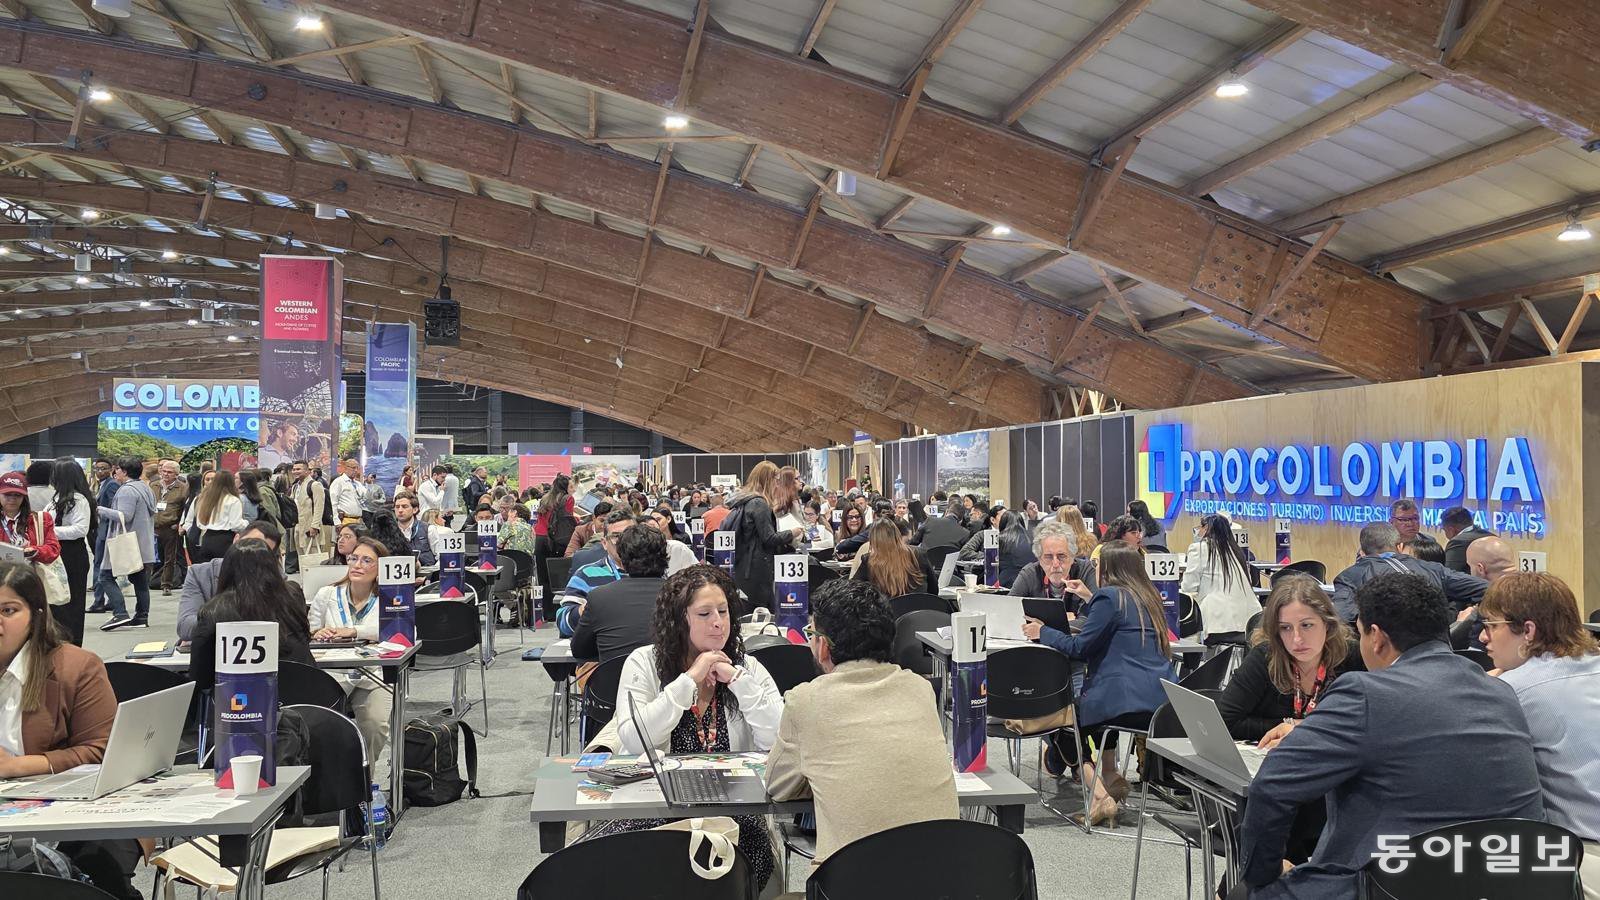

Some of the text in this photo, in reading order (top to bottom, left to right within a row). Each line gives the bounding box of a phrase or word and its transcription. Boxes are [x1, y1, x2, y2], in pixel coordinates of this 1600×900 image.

[274, 306, 318, 314] COLOMBIAN
[280, 299, 313, 307] WESTERN
[114, 382, 260, 411] COLOMB
[106, 416, 260, 432] THE COUNTRY O
[1181, 437, 1541, 502] PROCOLOMBIA
[1184, 498, 1543, 534] EXPORTACIONES TURISMO INVERSI MAA PAÍS
[480, 524, 494, 533] 144
[696, 522, 704, 532] 14
[1085, 521, 1093, 530] 14
[443, 538, 462, 550] 135
[385, 563, 411, 580] 134
[780, 561, 804, 578] 133
[1150, 560, 1175, 576] 132
[1518, 558, 1537, 573] 31
[969, 625, 987, 654] 12
[221, 635, 266, 665] 125
[221, 712, 263, 720] PROCOLOMBIA
